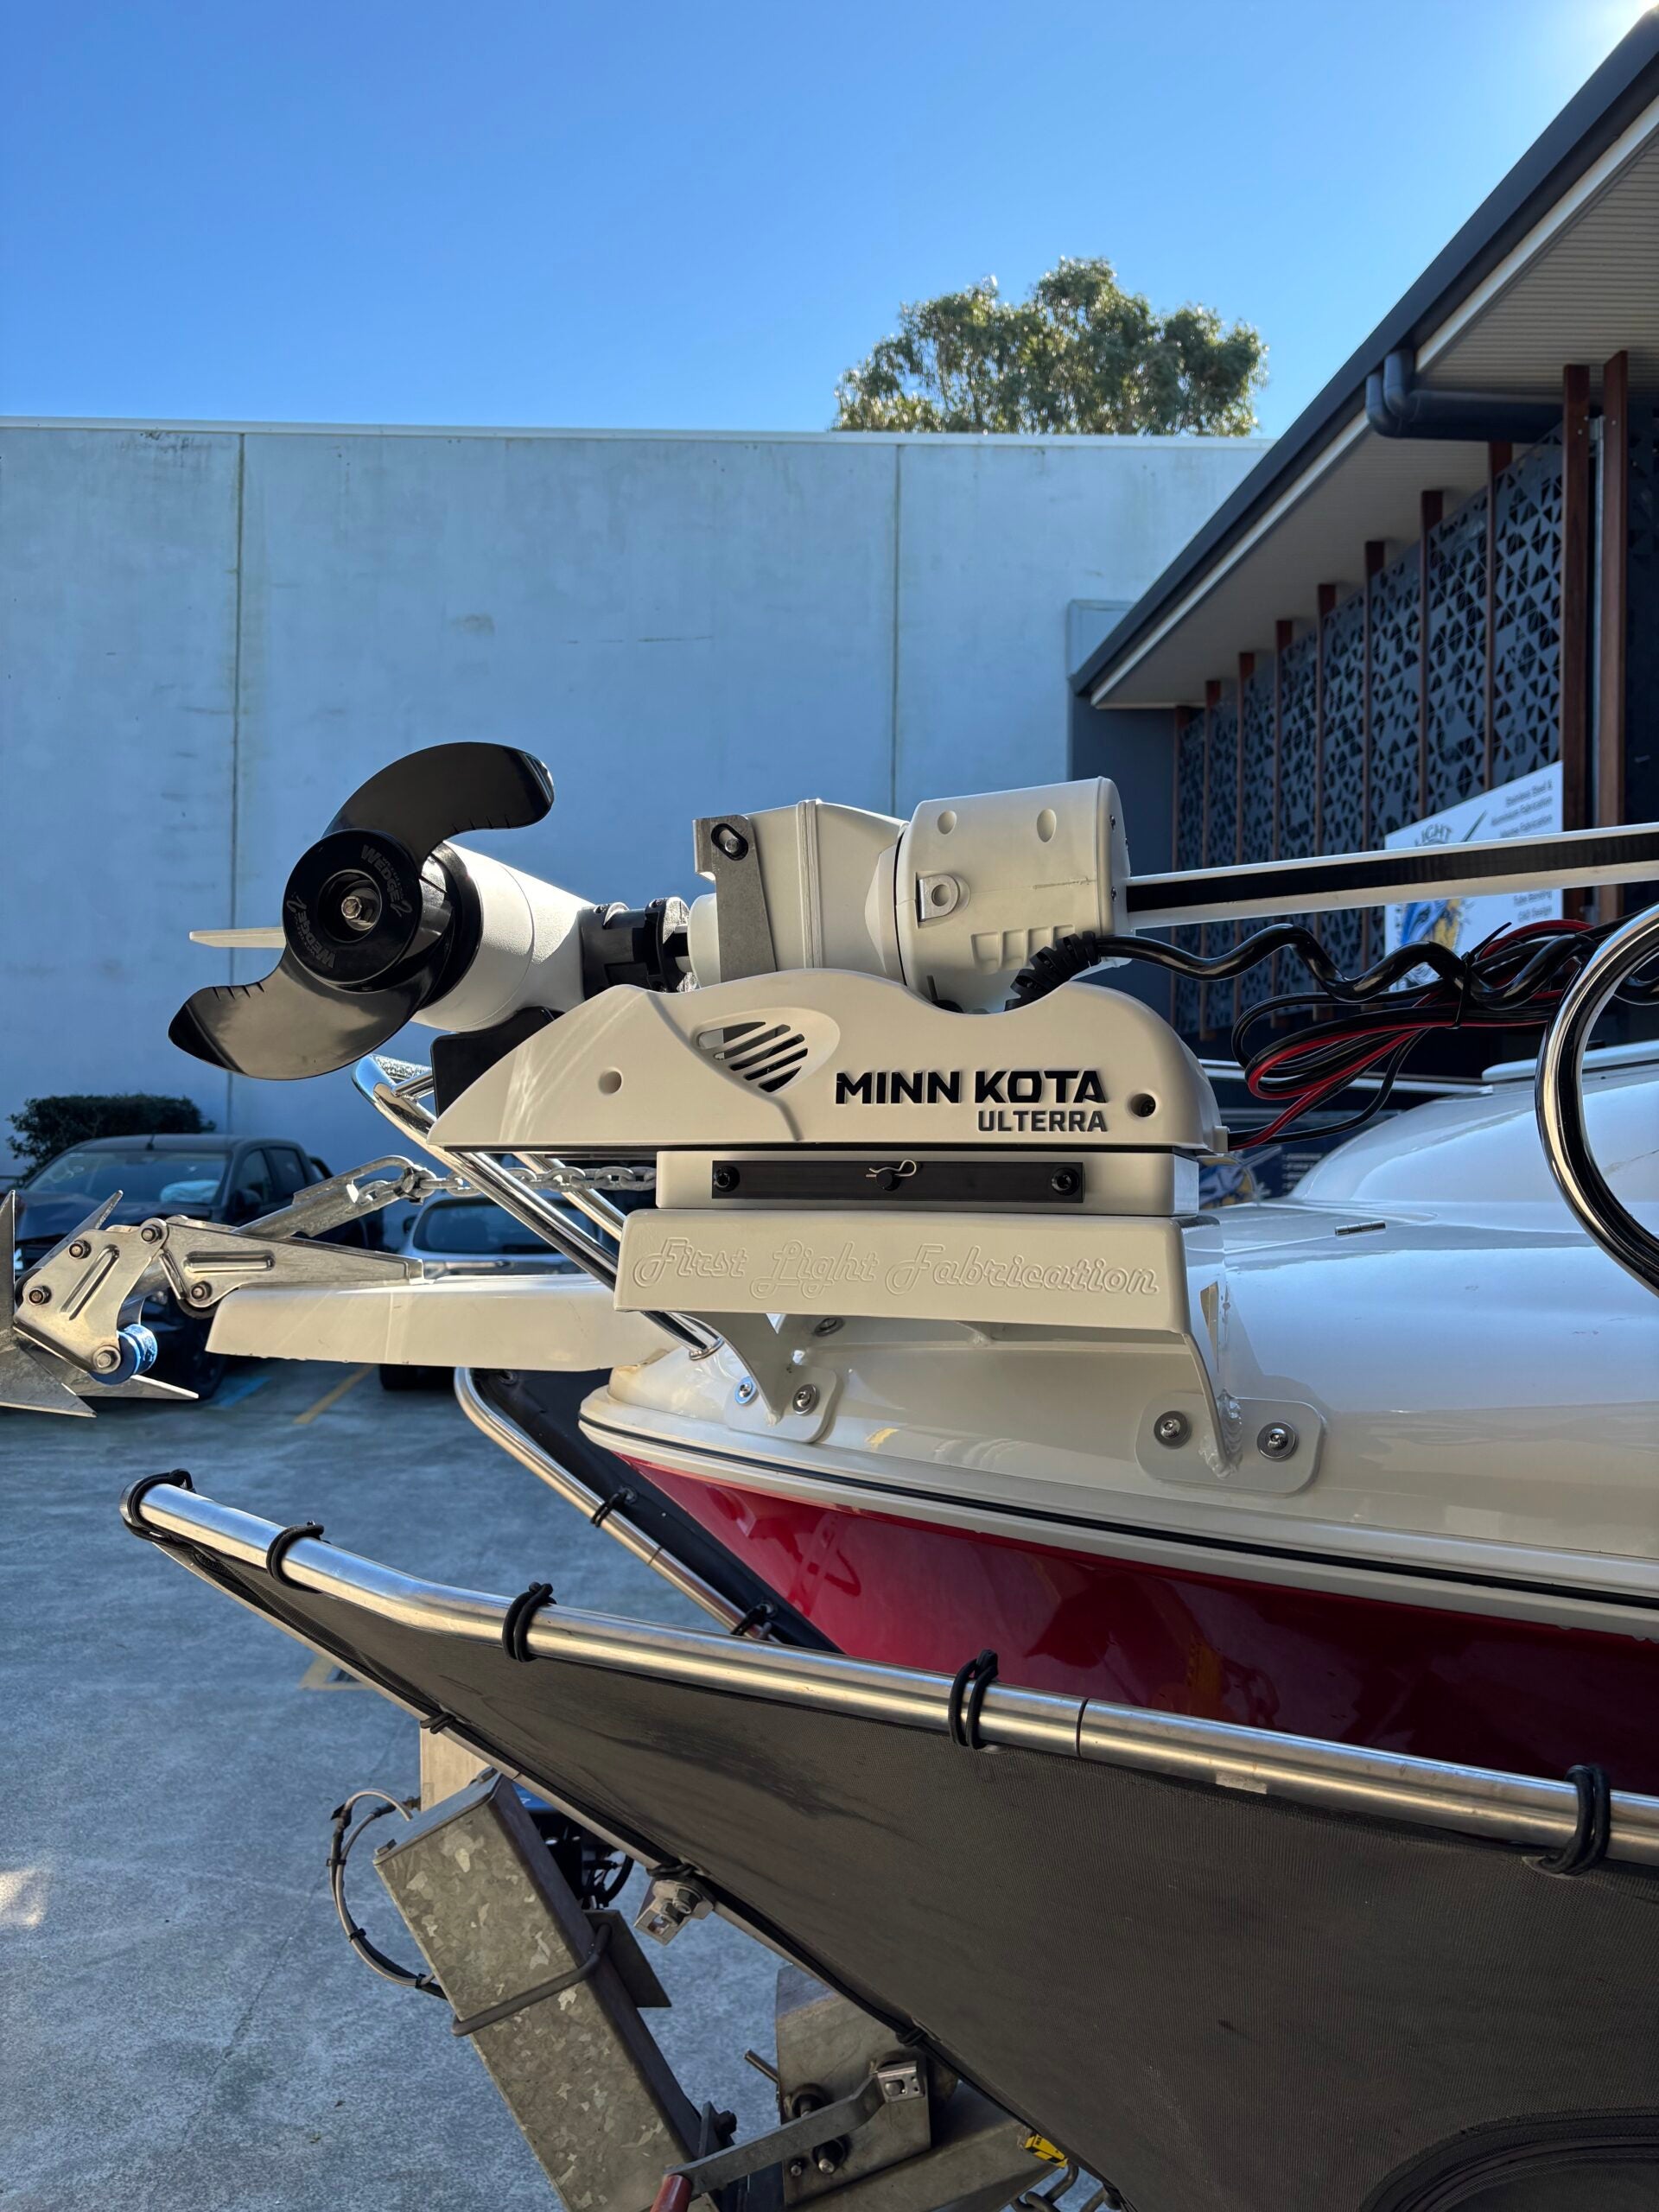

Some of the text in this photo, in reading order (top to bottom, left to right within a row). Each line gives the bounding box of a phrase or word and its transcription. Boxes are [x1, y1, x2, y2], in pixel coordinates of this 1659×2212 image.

[361, 844, 400, 903] WEDGE
[297, 911, 335, 968] WEDGE
[835, 1071, 1109, 1104] MINN KOTA
[977, 1110, 1108, 1132] ULTERRA
[632, 1236, 1160, 1300] First Light Fabrication
